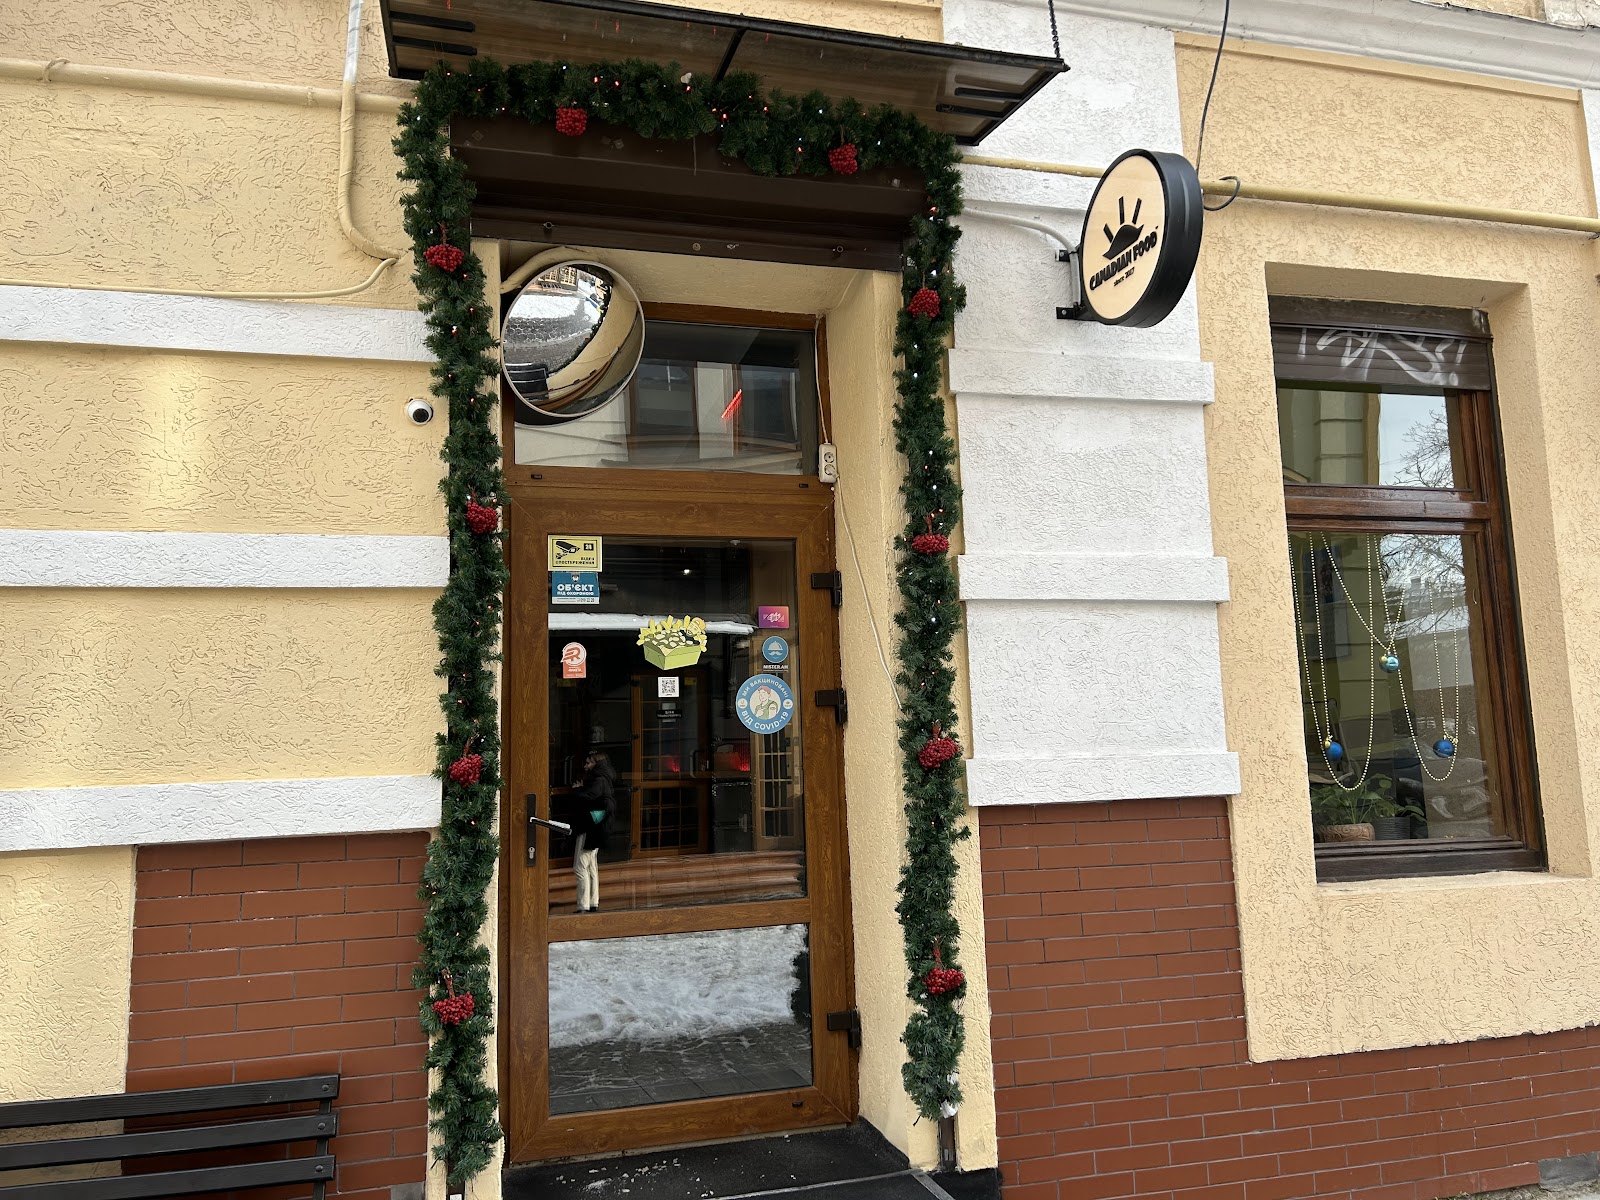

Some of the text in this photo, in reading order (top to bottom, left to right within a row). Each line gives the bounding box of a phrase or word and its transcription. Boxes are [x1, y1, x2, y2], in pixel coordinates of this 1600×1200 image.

[1089, 231, 1158, 290] CANADIAN FOOD
[1113, 276, 1124, 286] since
[742, 678, 789, 698] МИ ВАКЦИНОВАНІ
[741, 710, 789, 731] ВІД COVID-19
